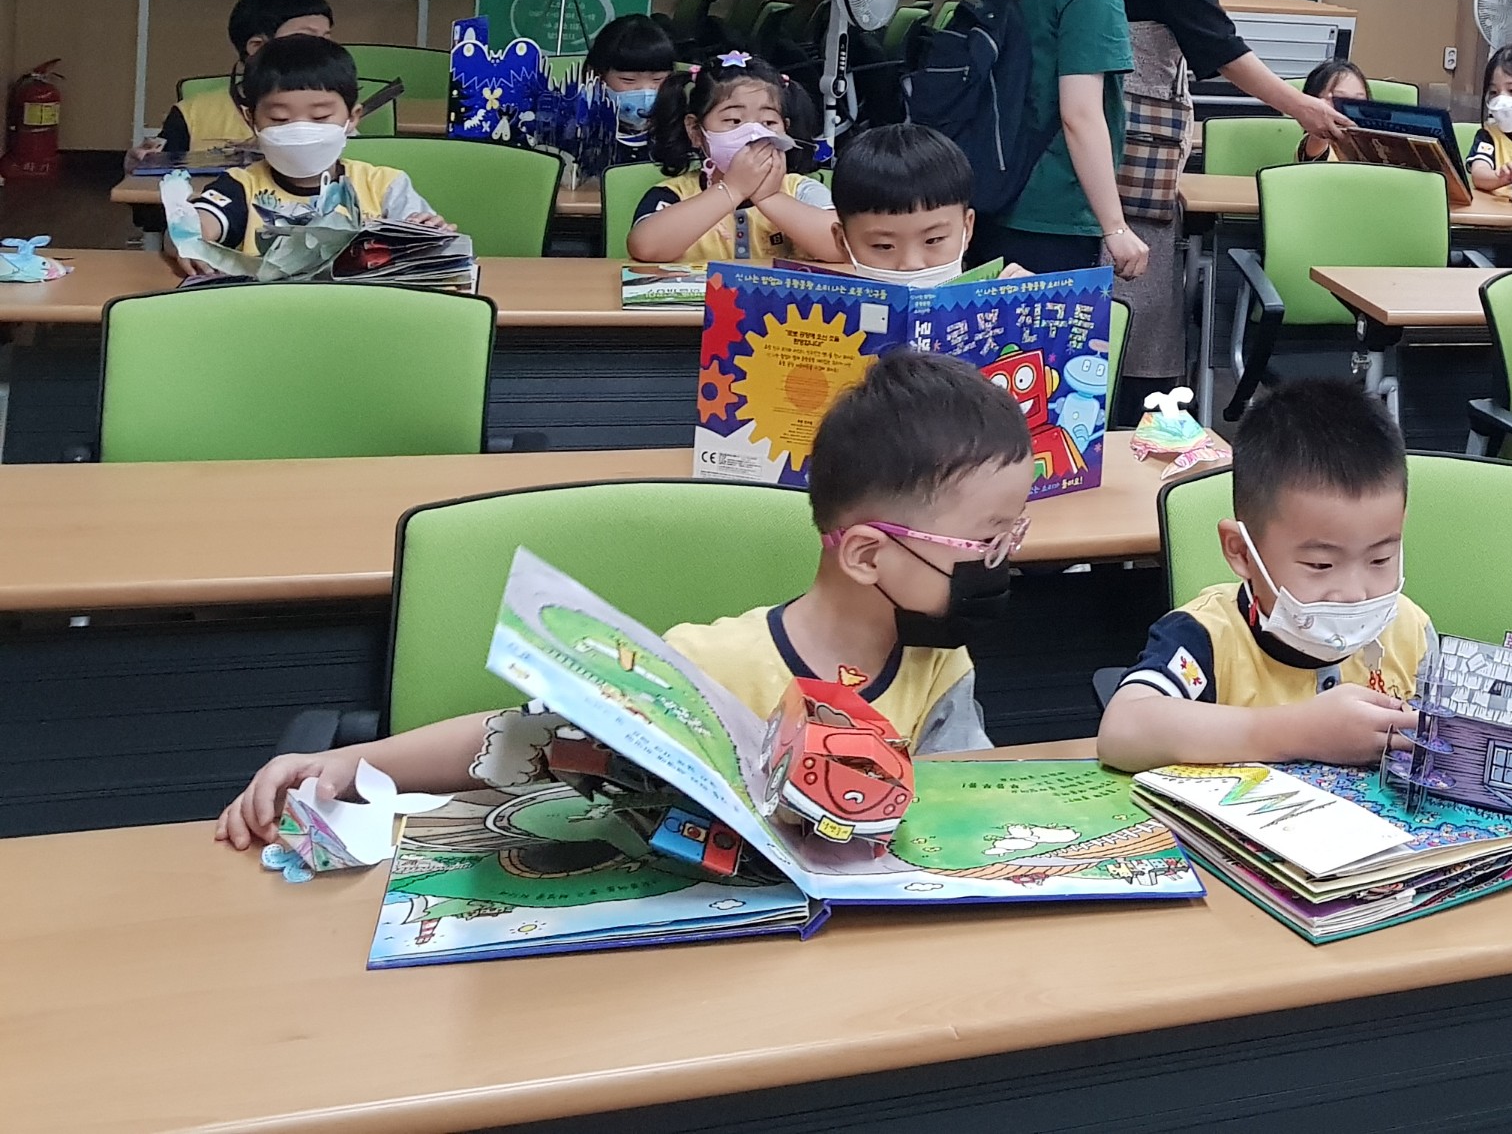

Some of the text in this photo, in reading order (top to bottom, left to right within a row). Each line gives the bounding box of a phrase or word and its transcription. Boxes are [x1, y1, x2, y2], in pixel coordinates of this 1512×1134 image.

[848, 287, 864, 297] 로봇
[864, 287, 888, 300] 친구들
[946, 302, 1095, 356] 로봇 친구들
